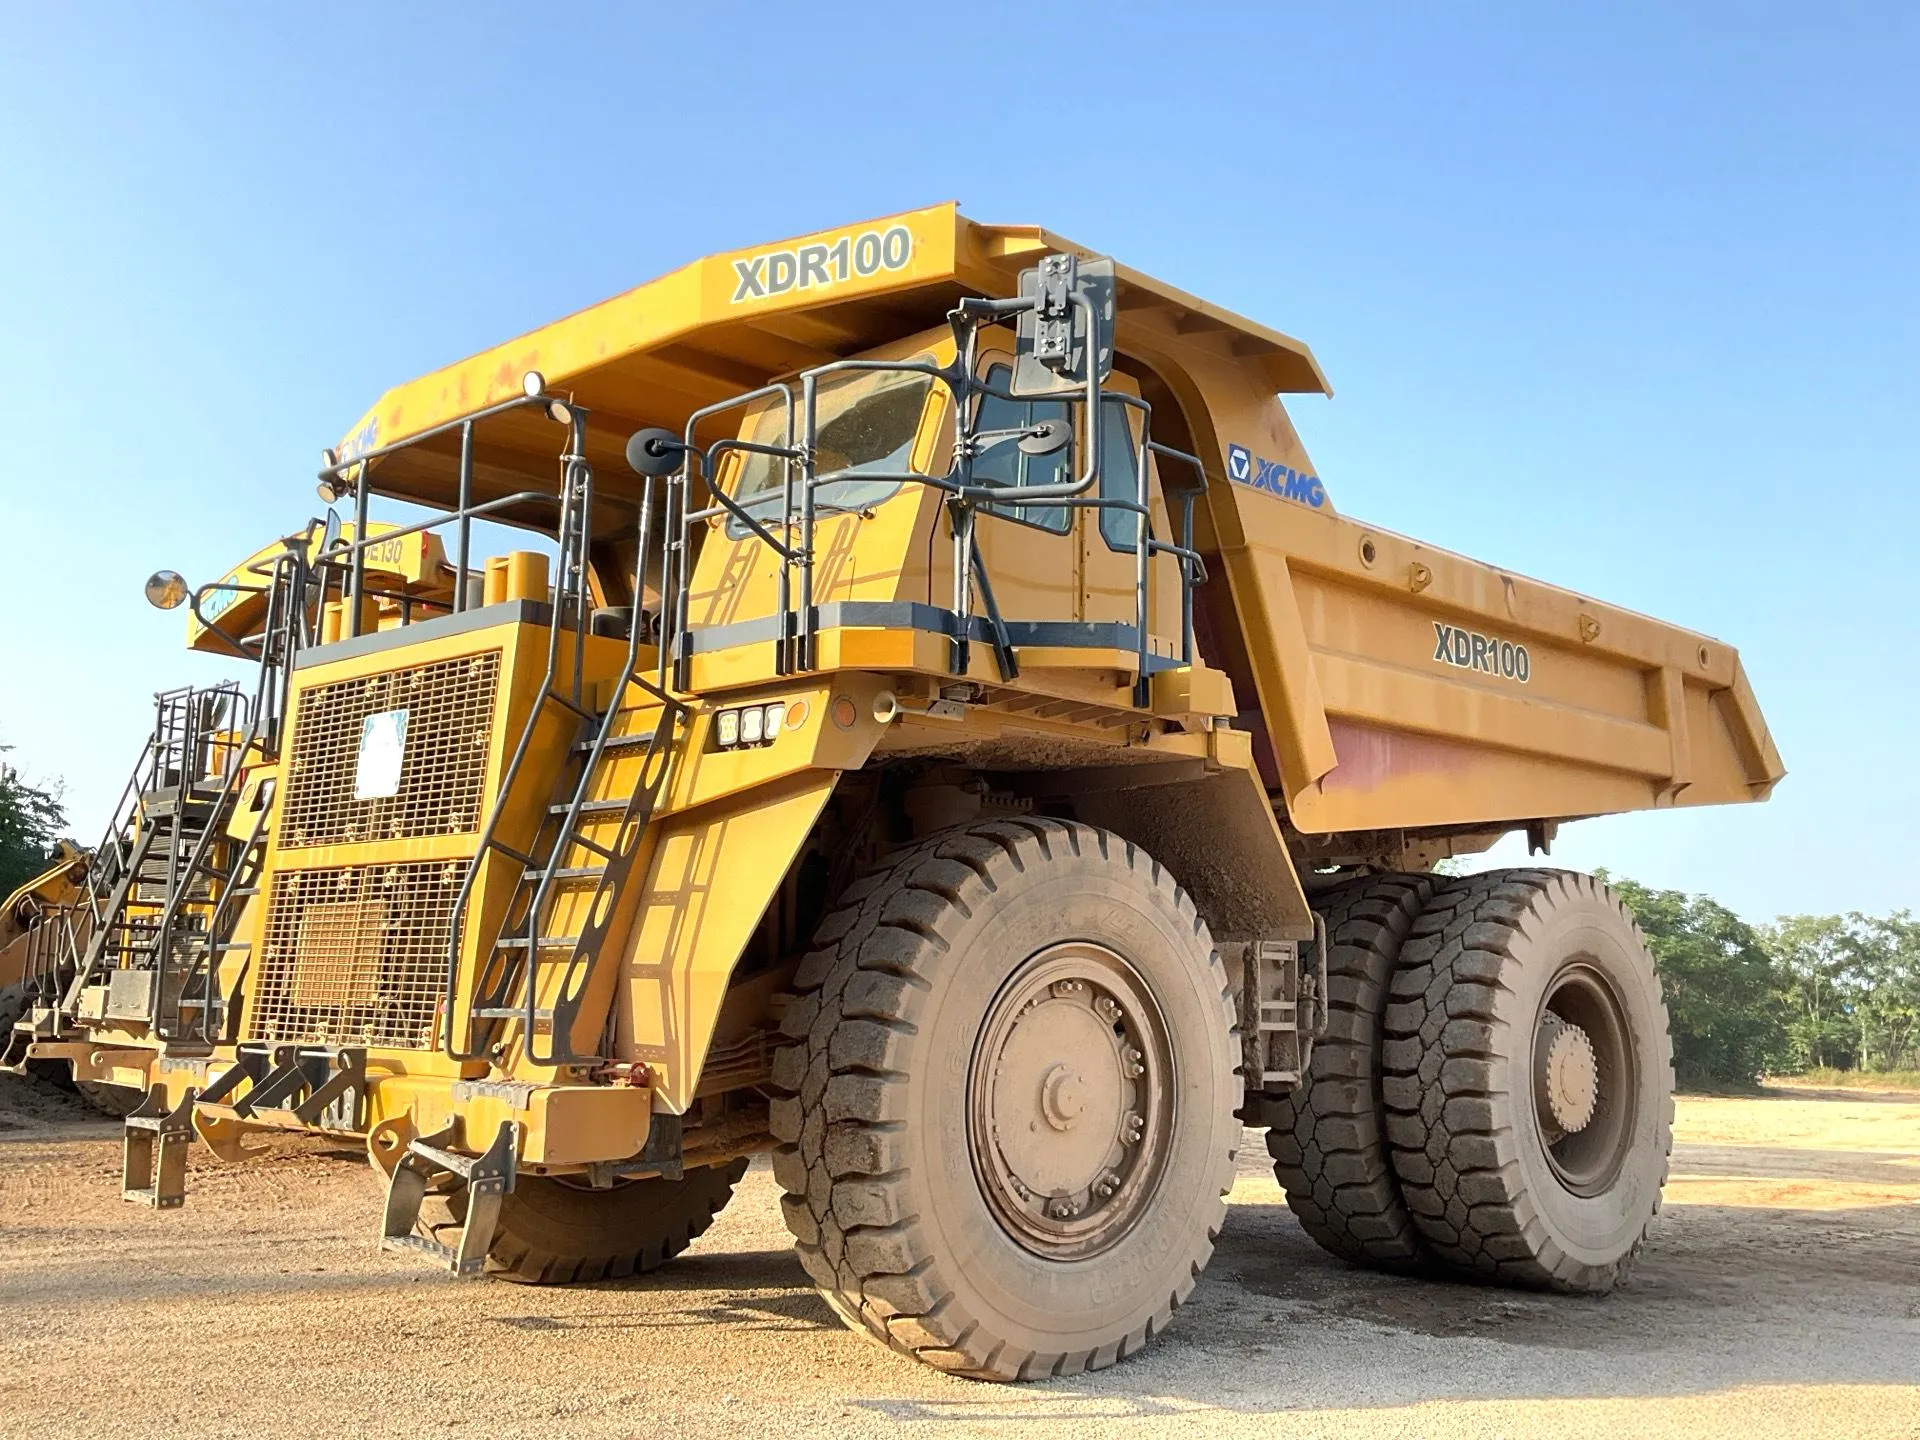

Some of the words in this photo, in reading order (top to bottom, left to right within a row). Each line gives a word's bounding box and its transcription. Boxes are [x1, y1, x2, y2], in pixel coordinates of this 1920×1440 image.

[731, 224, 912, 304] XDR100
[1250, 456, 1325, 508] XCMG
[1432, 621, 1530, 683] XDR100
